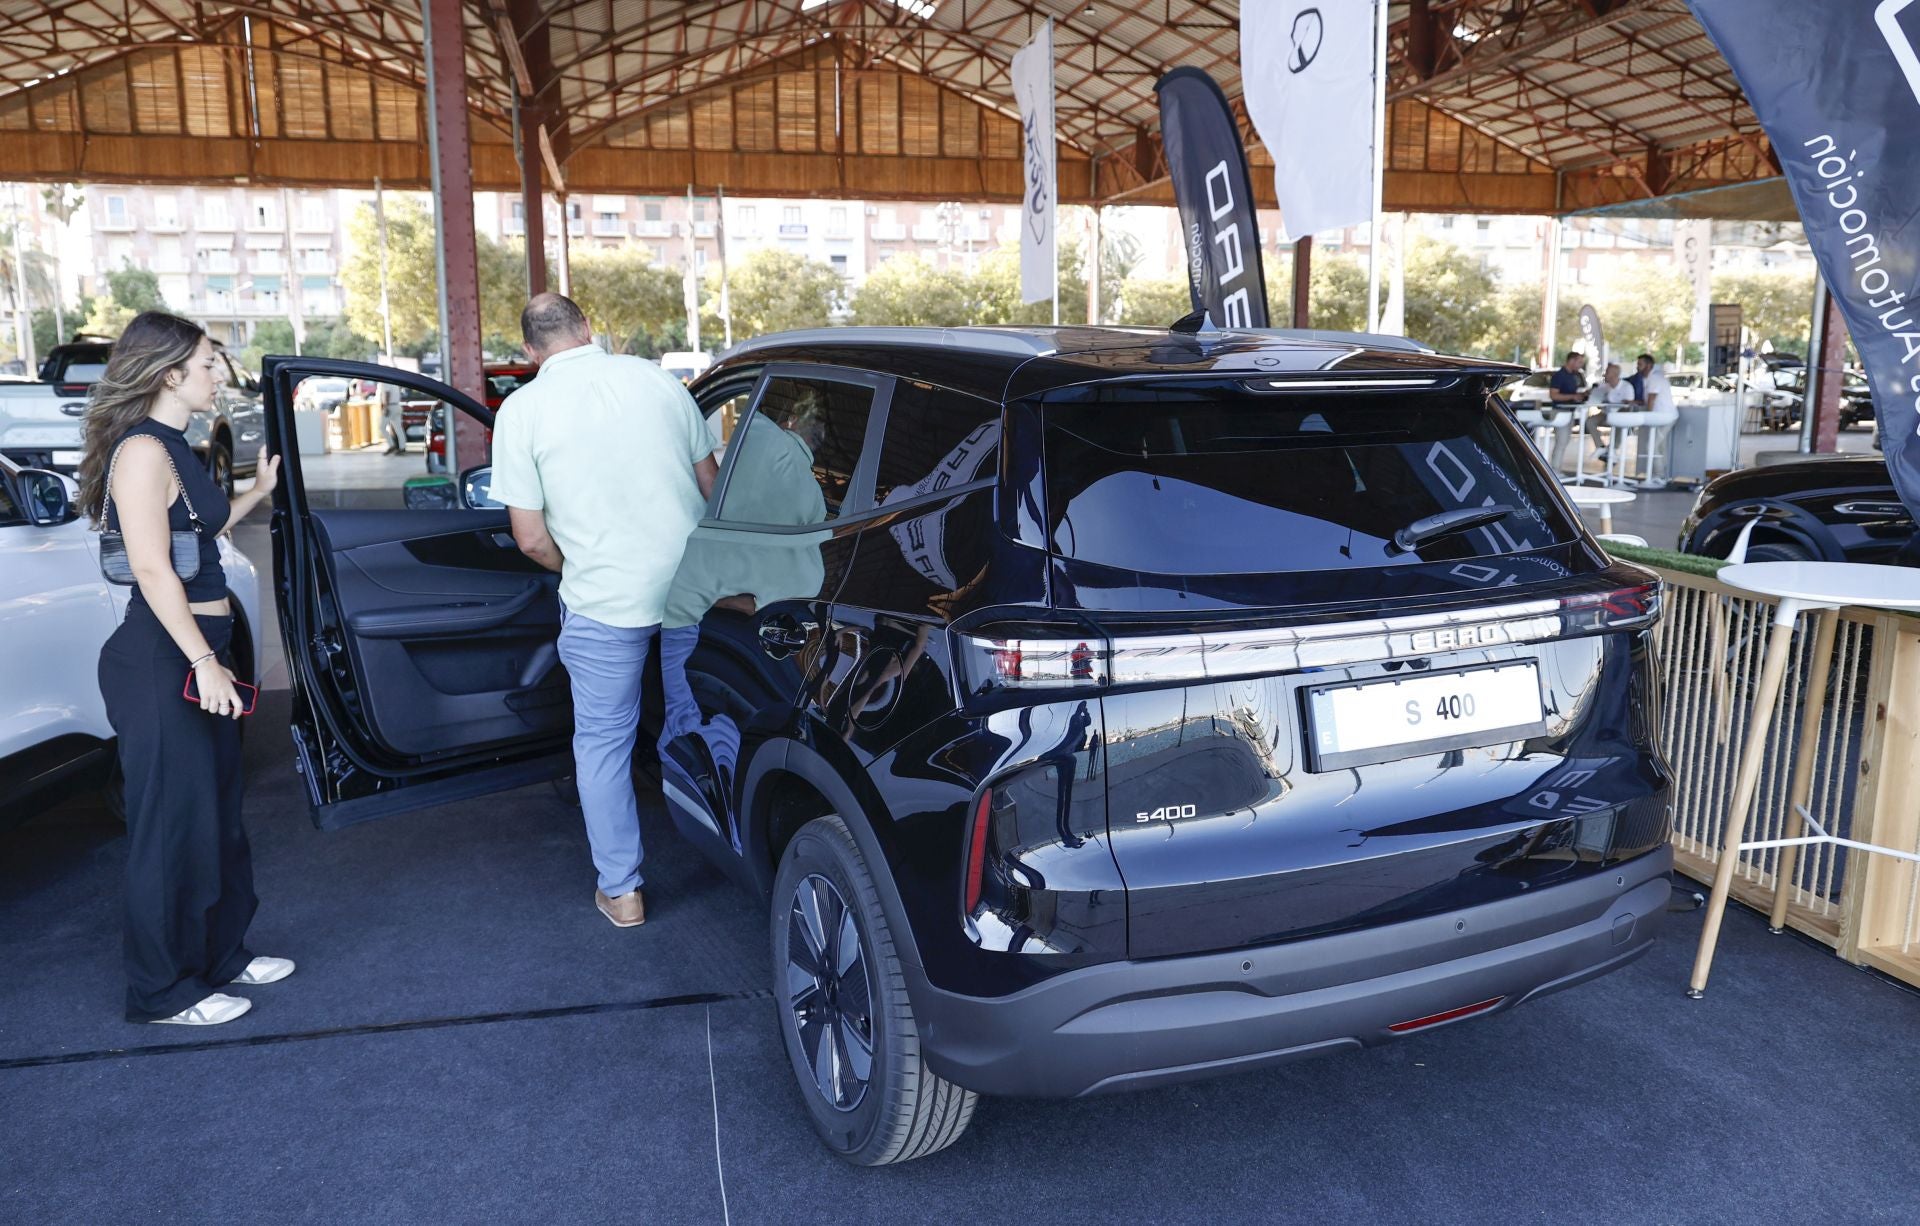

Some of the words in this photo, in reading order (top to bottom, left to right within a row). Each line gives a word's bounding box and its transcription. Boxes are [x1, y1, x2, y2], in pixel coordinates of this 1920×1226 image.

[1410, 623, 1499, 651] EBRO
[1405, 700, 1422, 725] S
[1436, 693, 1476, 720] 400
[1322, 731, 1333, 745] E
